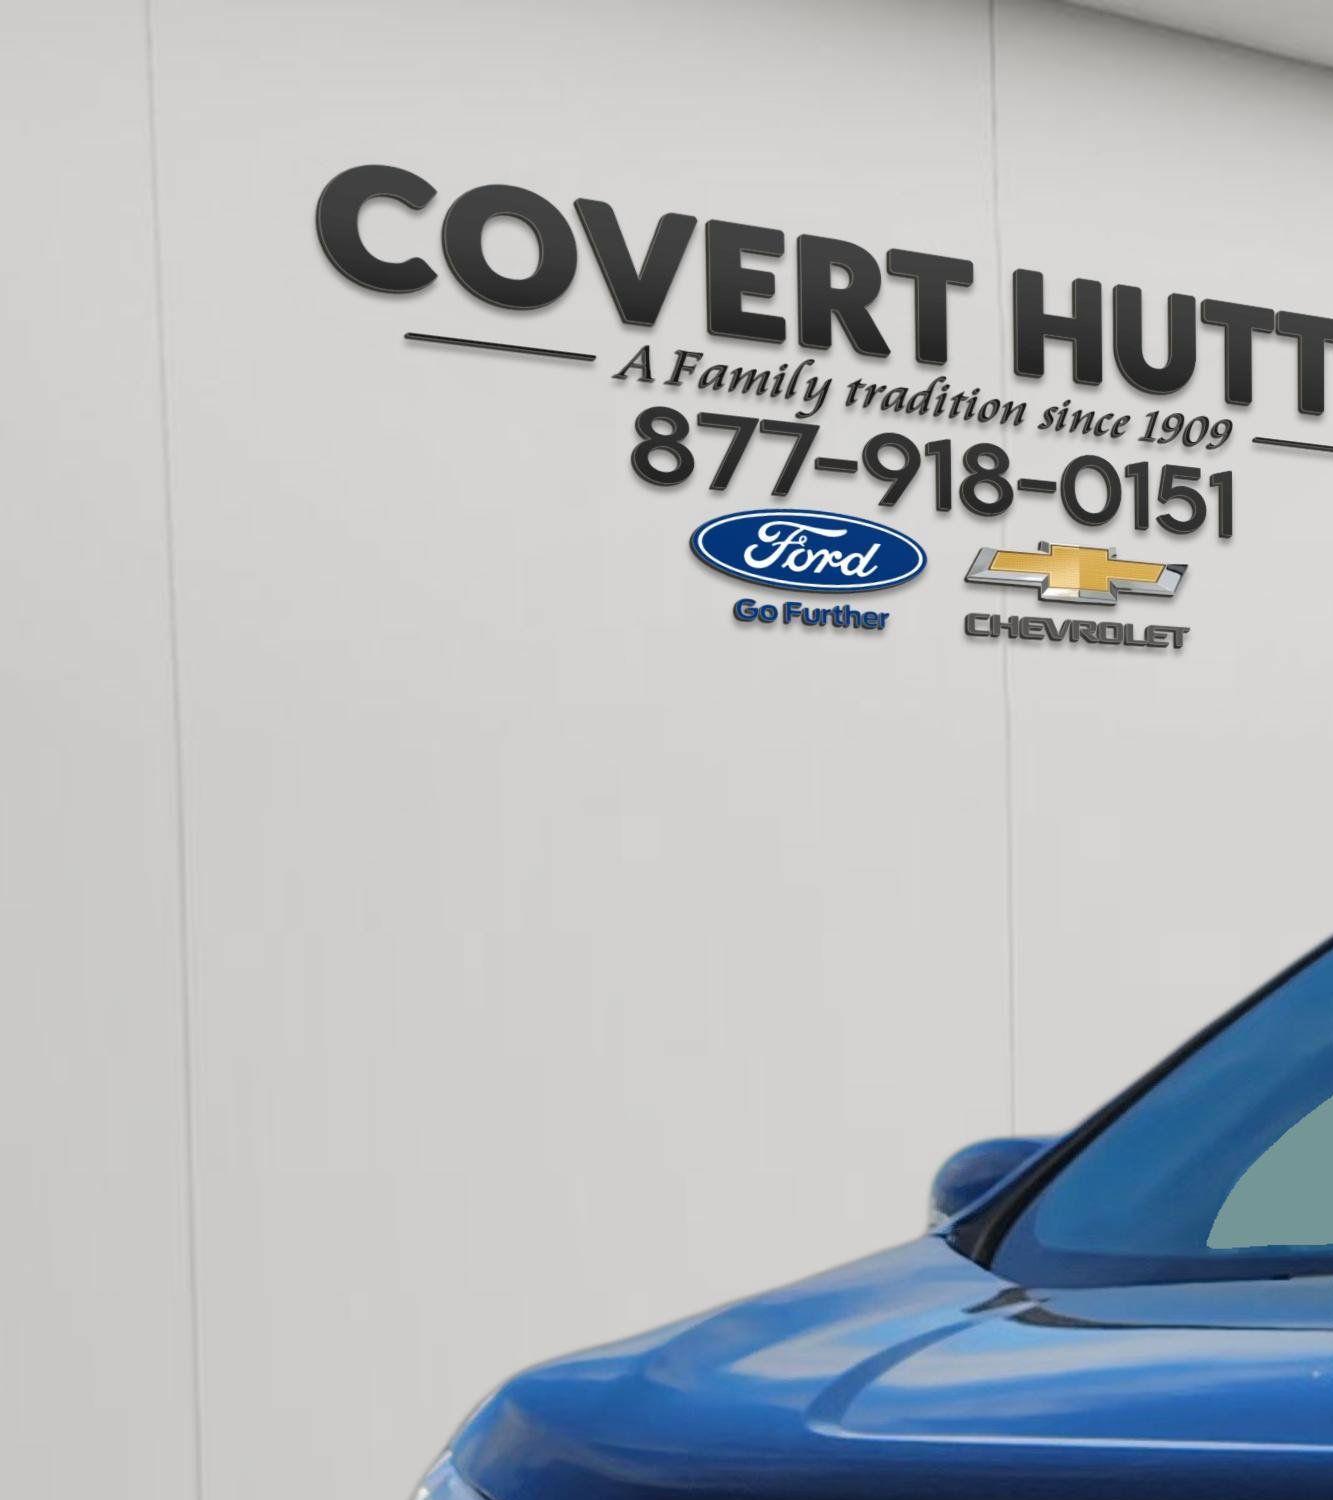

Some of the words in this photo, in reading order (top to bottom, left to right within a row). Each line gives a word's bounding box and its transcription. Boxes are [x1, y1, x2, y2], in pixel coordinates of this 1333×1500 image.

[315, 164, 974, 365] COVERT
[612, 345, 656, 383] A
[664, 349, 832, 418] Family
[846, 376, 1027, 426] tradition
[1038, 400, 1131, 438] since
[1138, 410, 1234, 450] 1909
[631, 406, 1233, 538] 877-918-0151
[744, 521, 881, 577] Ford
[733, 598, 778, 623] Go
[783, 600, 889, 630] Further
[965, 612, 1190, 648] CHEVROLET
